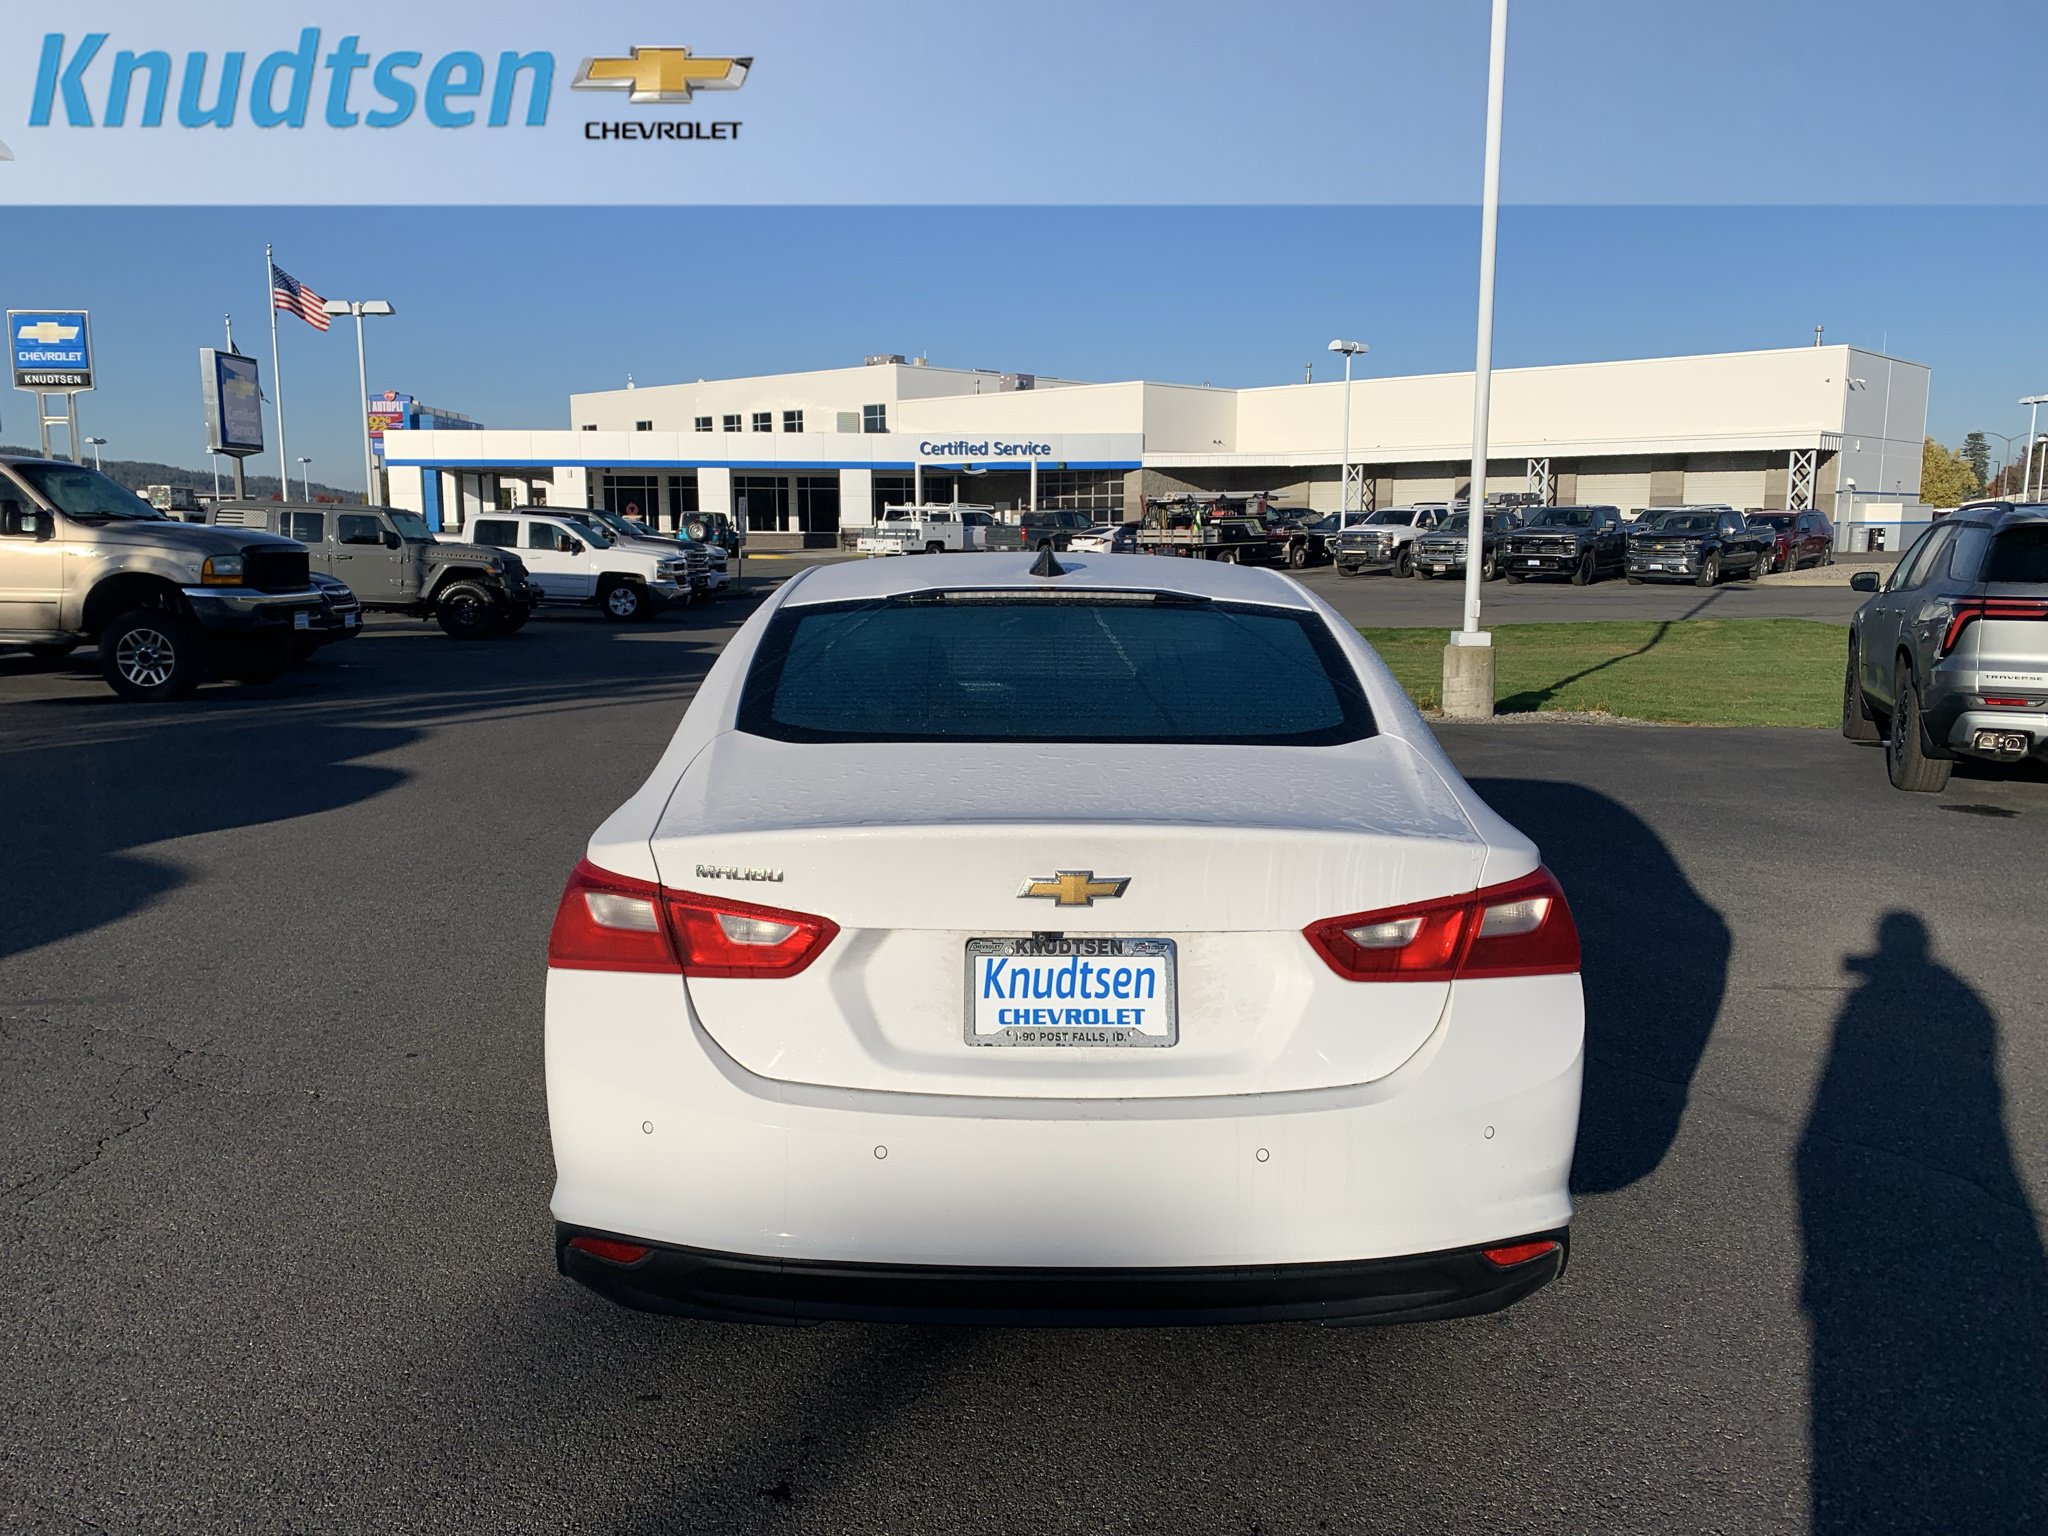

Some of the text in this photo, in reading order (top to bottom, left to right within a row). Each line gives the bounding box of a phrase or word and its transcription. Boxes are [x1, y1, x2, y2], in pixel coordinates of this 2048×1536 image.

[18, 351, 82, 361] CHEVROLET
[24, 374, 82, 384] KNUDTSEN
[919, 441, 1052, 456] Certified Service
[695, 864, 784, 882] MALIBU
[1015, 939, 1123, 955] KNUDTSEN
[983, 956, 1156, 999] Knudtsen
[998, 1008, 1146, 1025] CHEVROLET
[1039, 1032, 1069, 1042] POST
[1072, 1032, 1109, 1043] FALLS,
[1112, 1032, 1127, 1042] ID.
